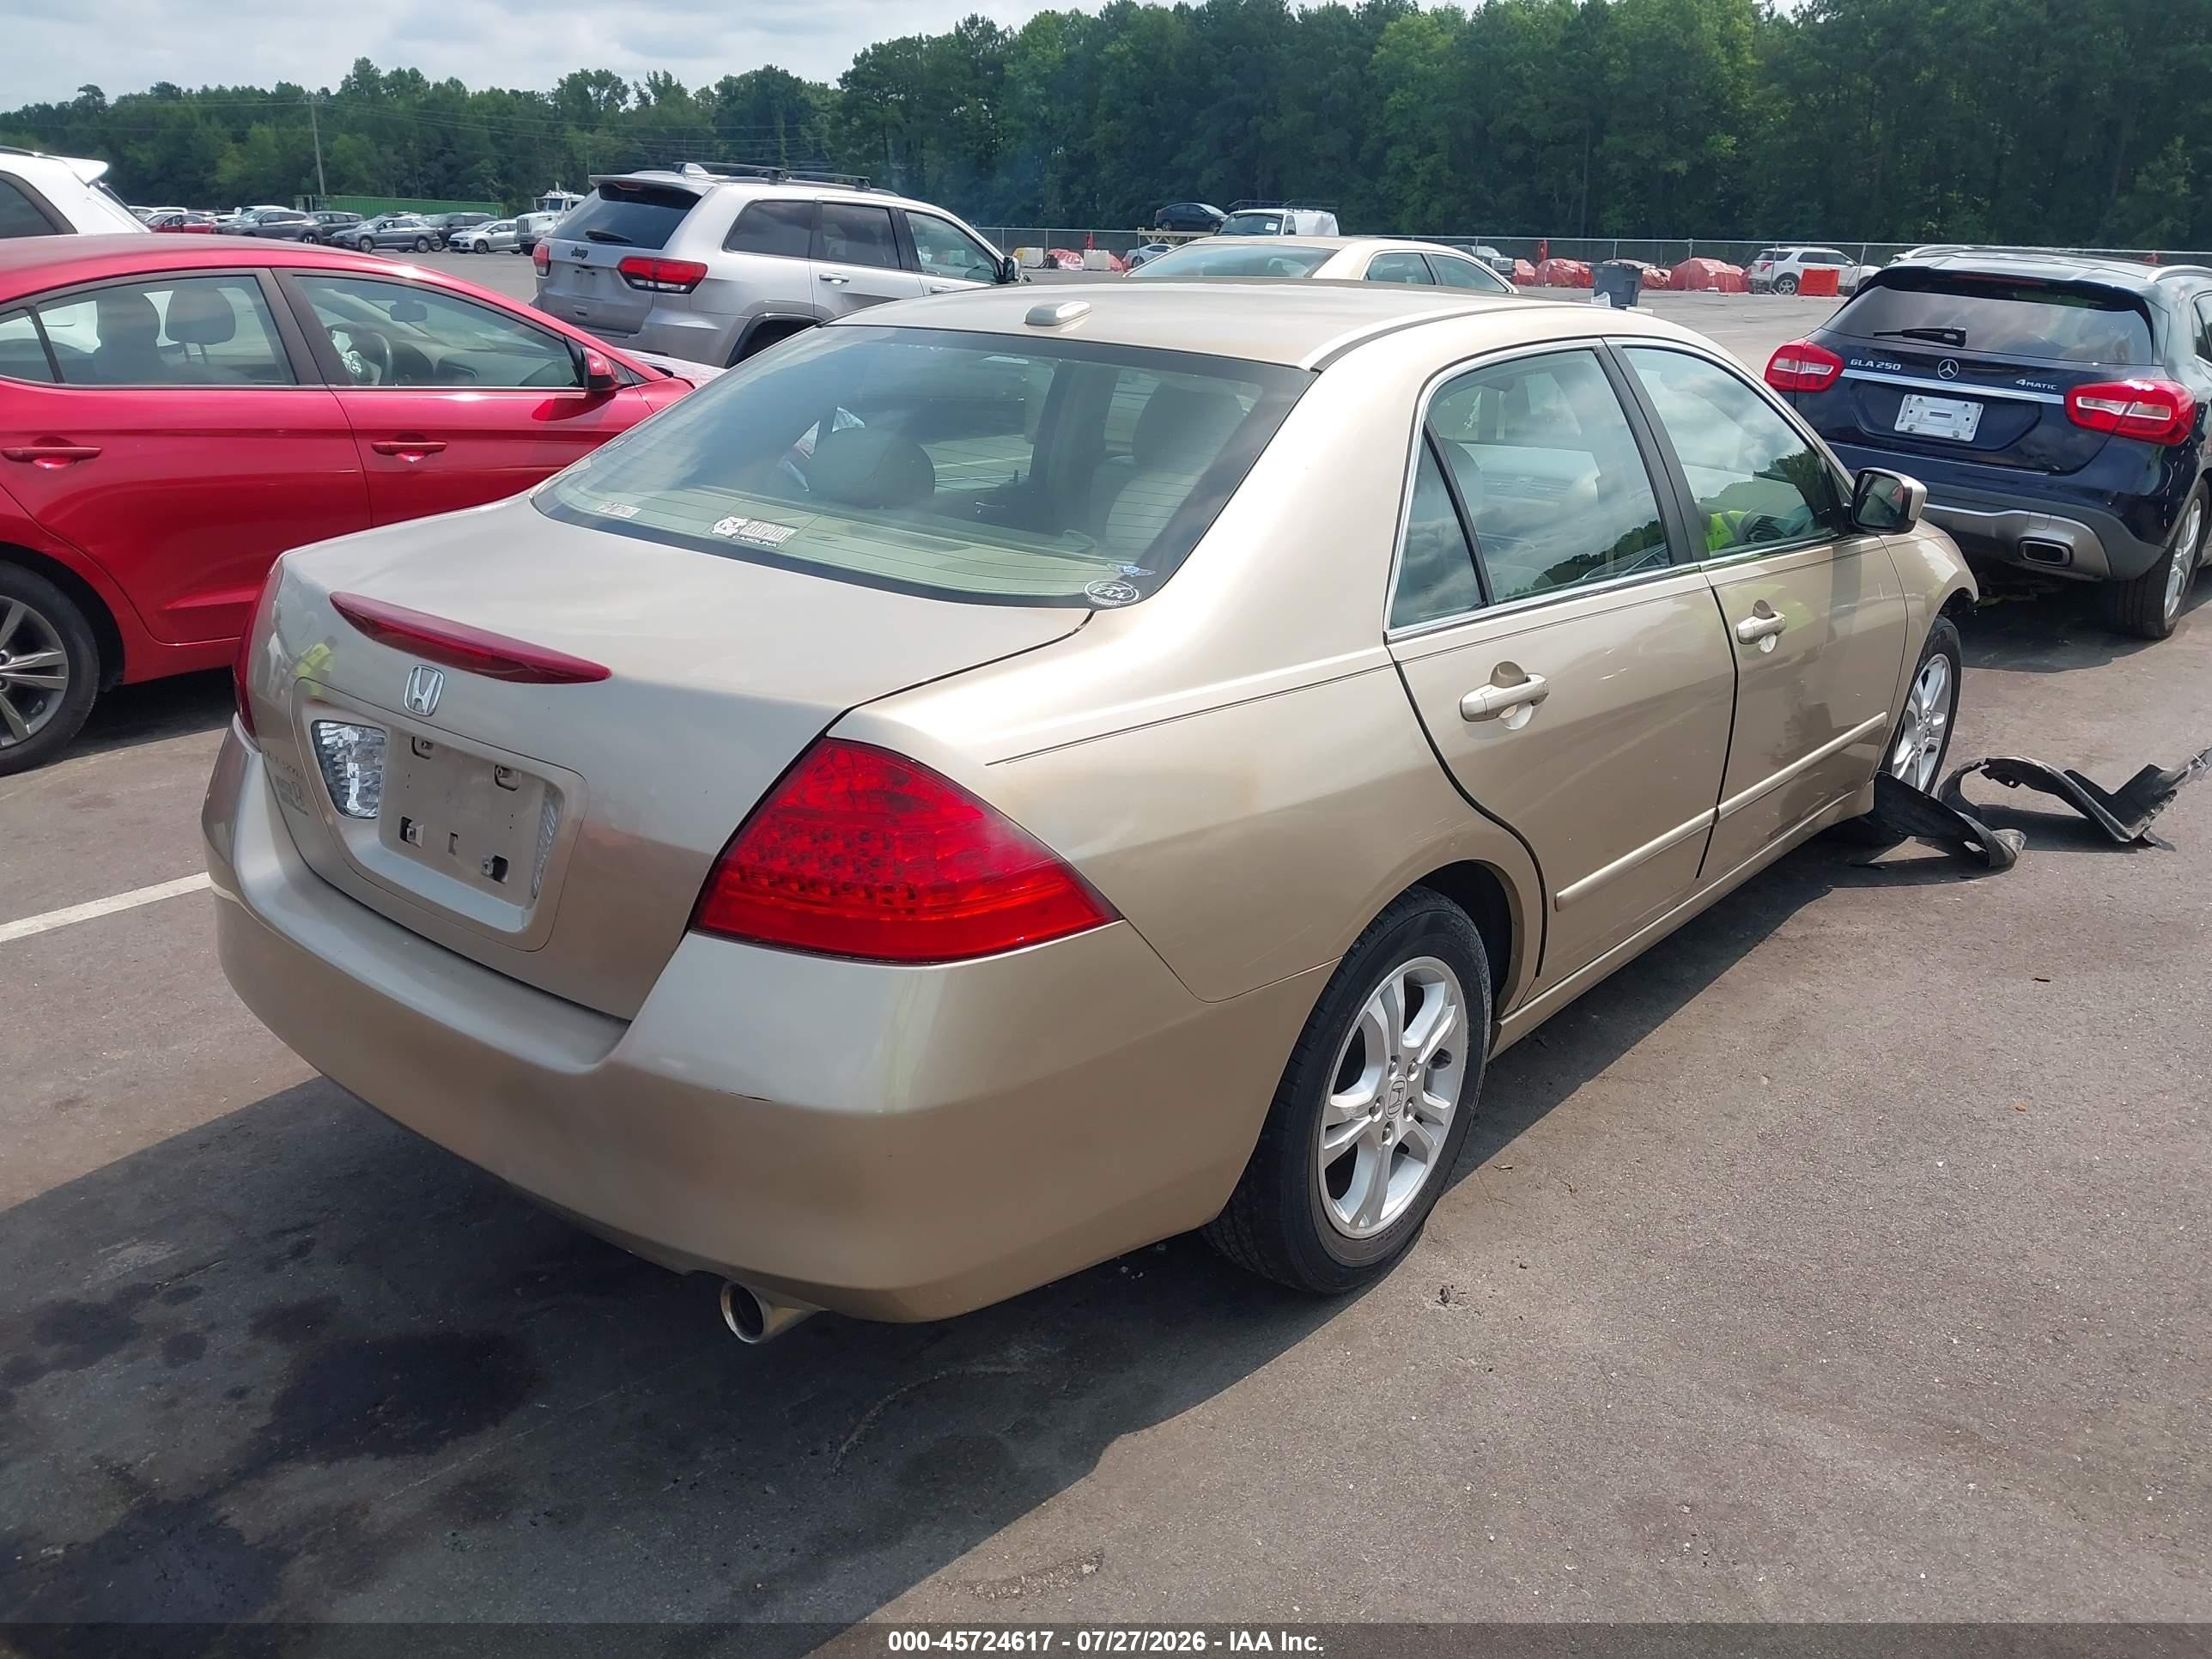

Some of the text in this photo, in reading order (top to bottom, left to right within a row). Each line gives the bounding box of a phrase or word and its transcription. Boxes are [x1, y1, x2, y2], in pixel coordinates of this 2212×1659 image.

[570, 246, 588, 260] Jeep
[1850, 358, 1902, 371] GLA 250
[2015, 379, 2057, 390] 4MATIC
[1091, 587, 1125, 599] EAA
